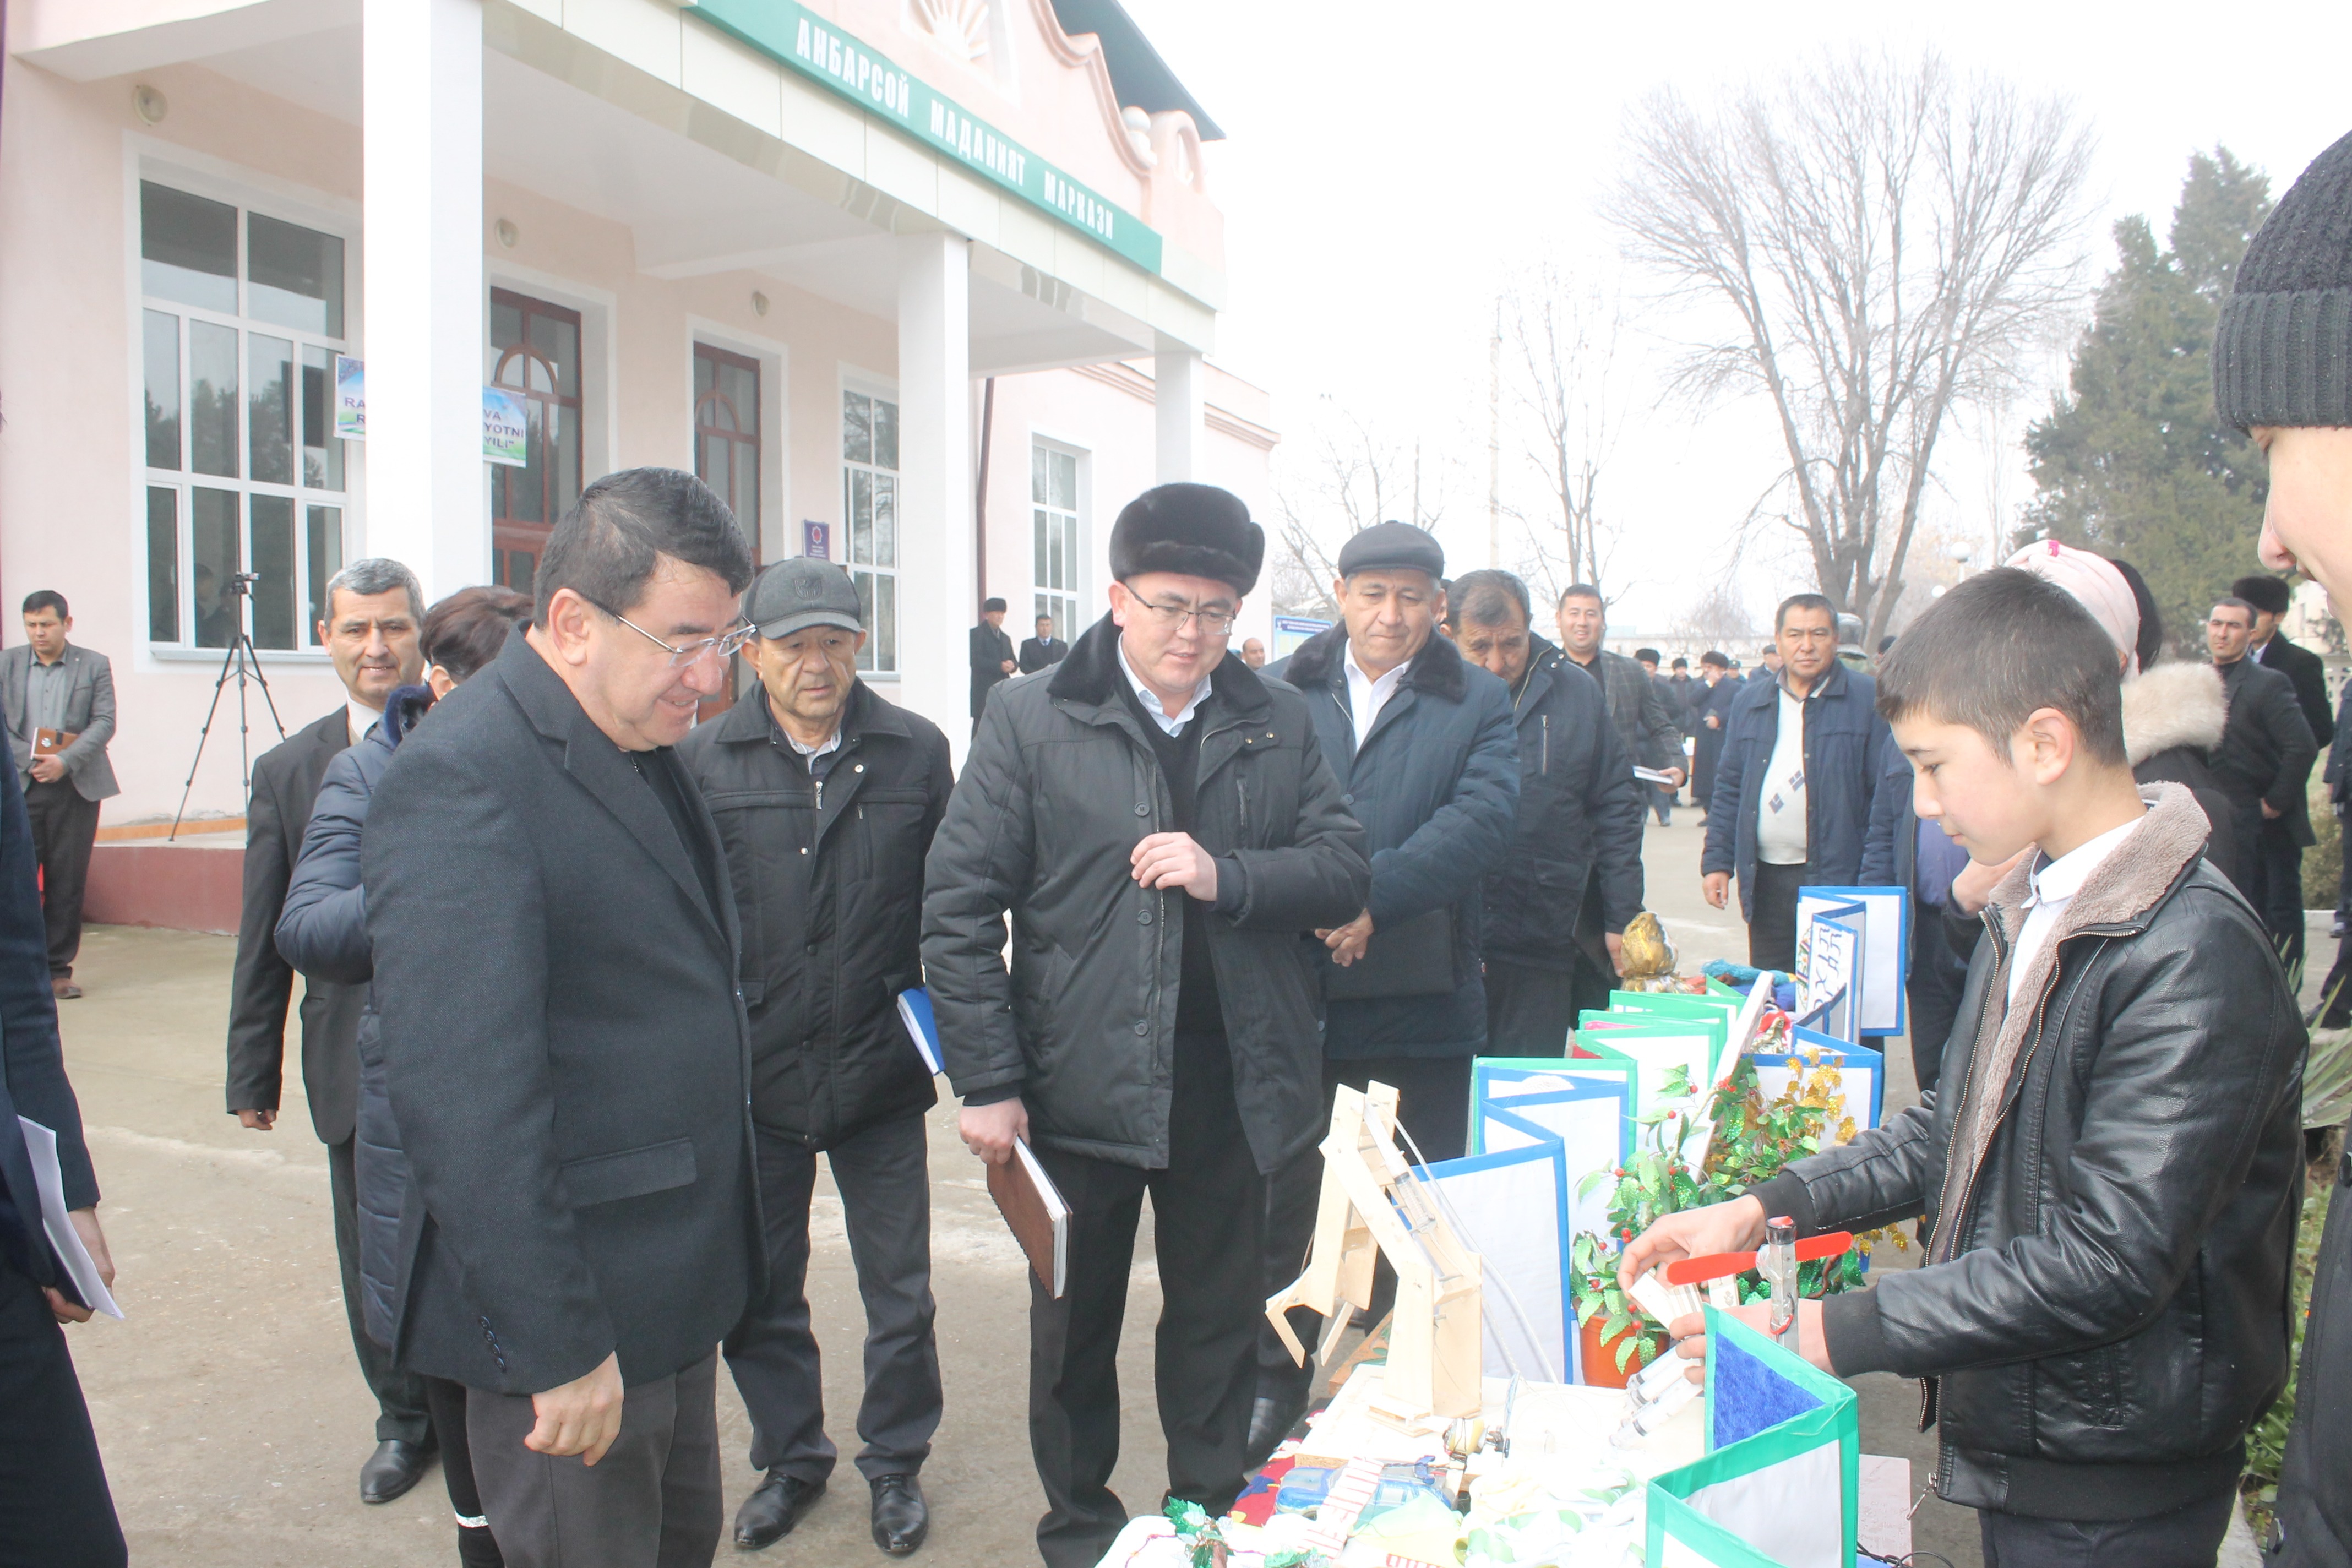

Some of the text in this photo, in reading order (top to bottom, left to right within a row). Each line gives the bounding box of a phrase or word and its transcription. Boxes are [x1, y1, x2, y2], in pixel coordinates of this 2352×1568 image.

[796, 17, 1114, 240] АНБАРСОЙ МАДАНИЯТ МАРКАЗИ
